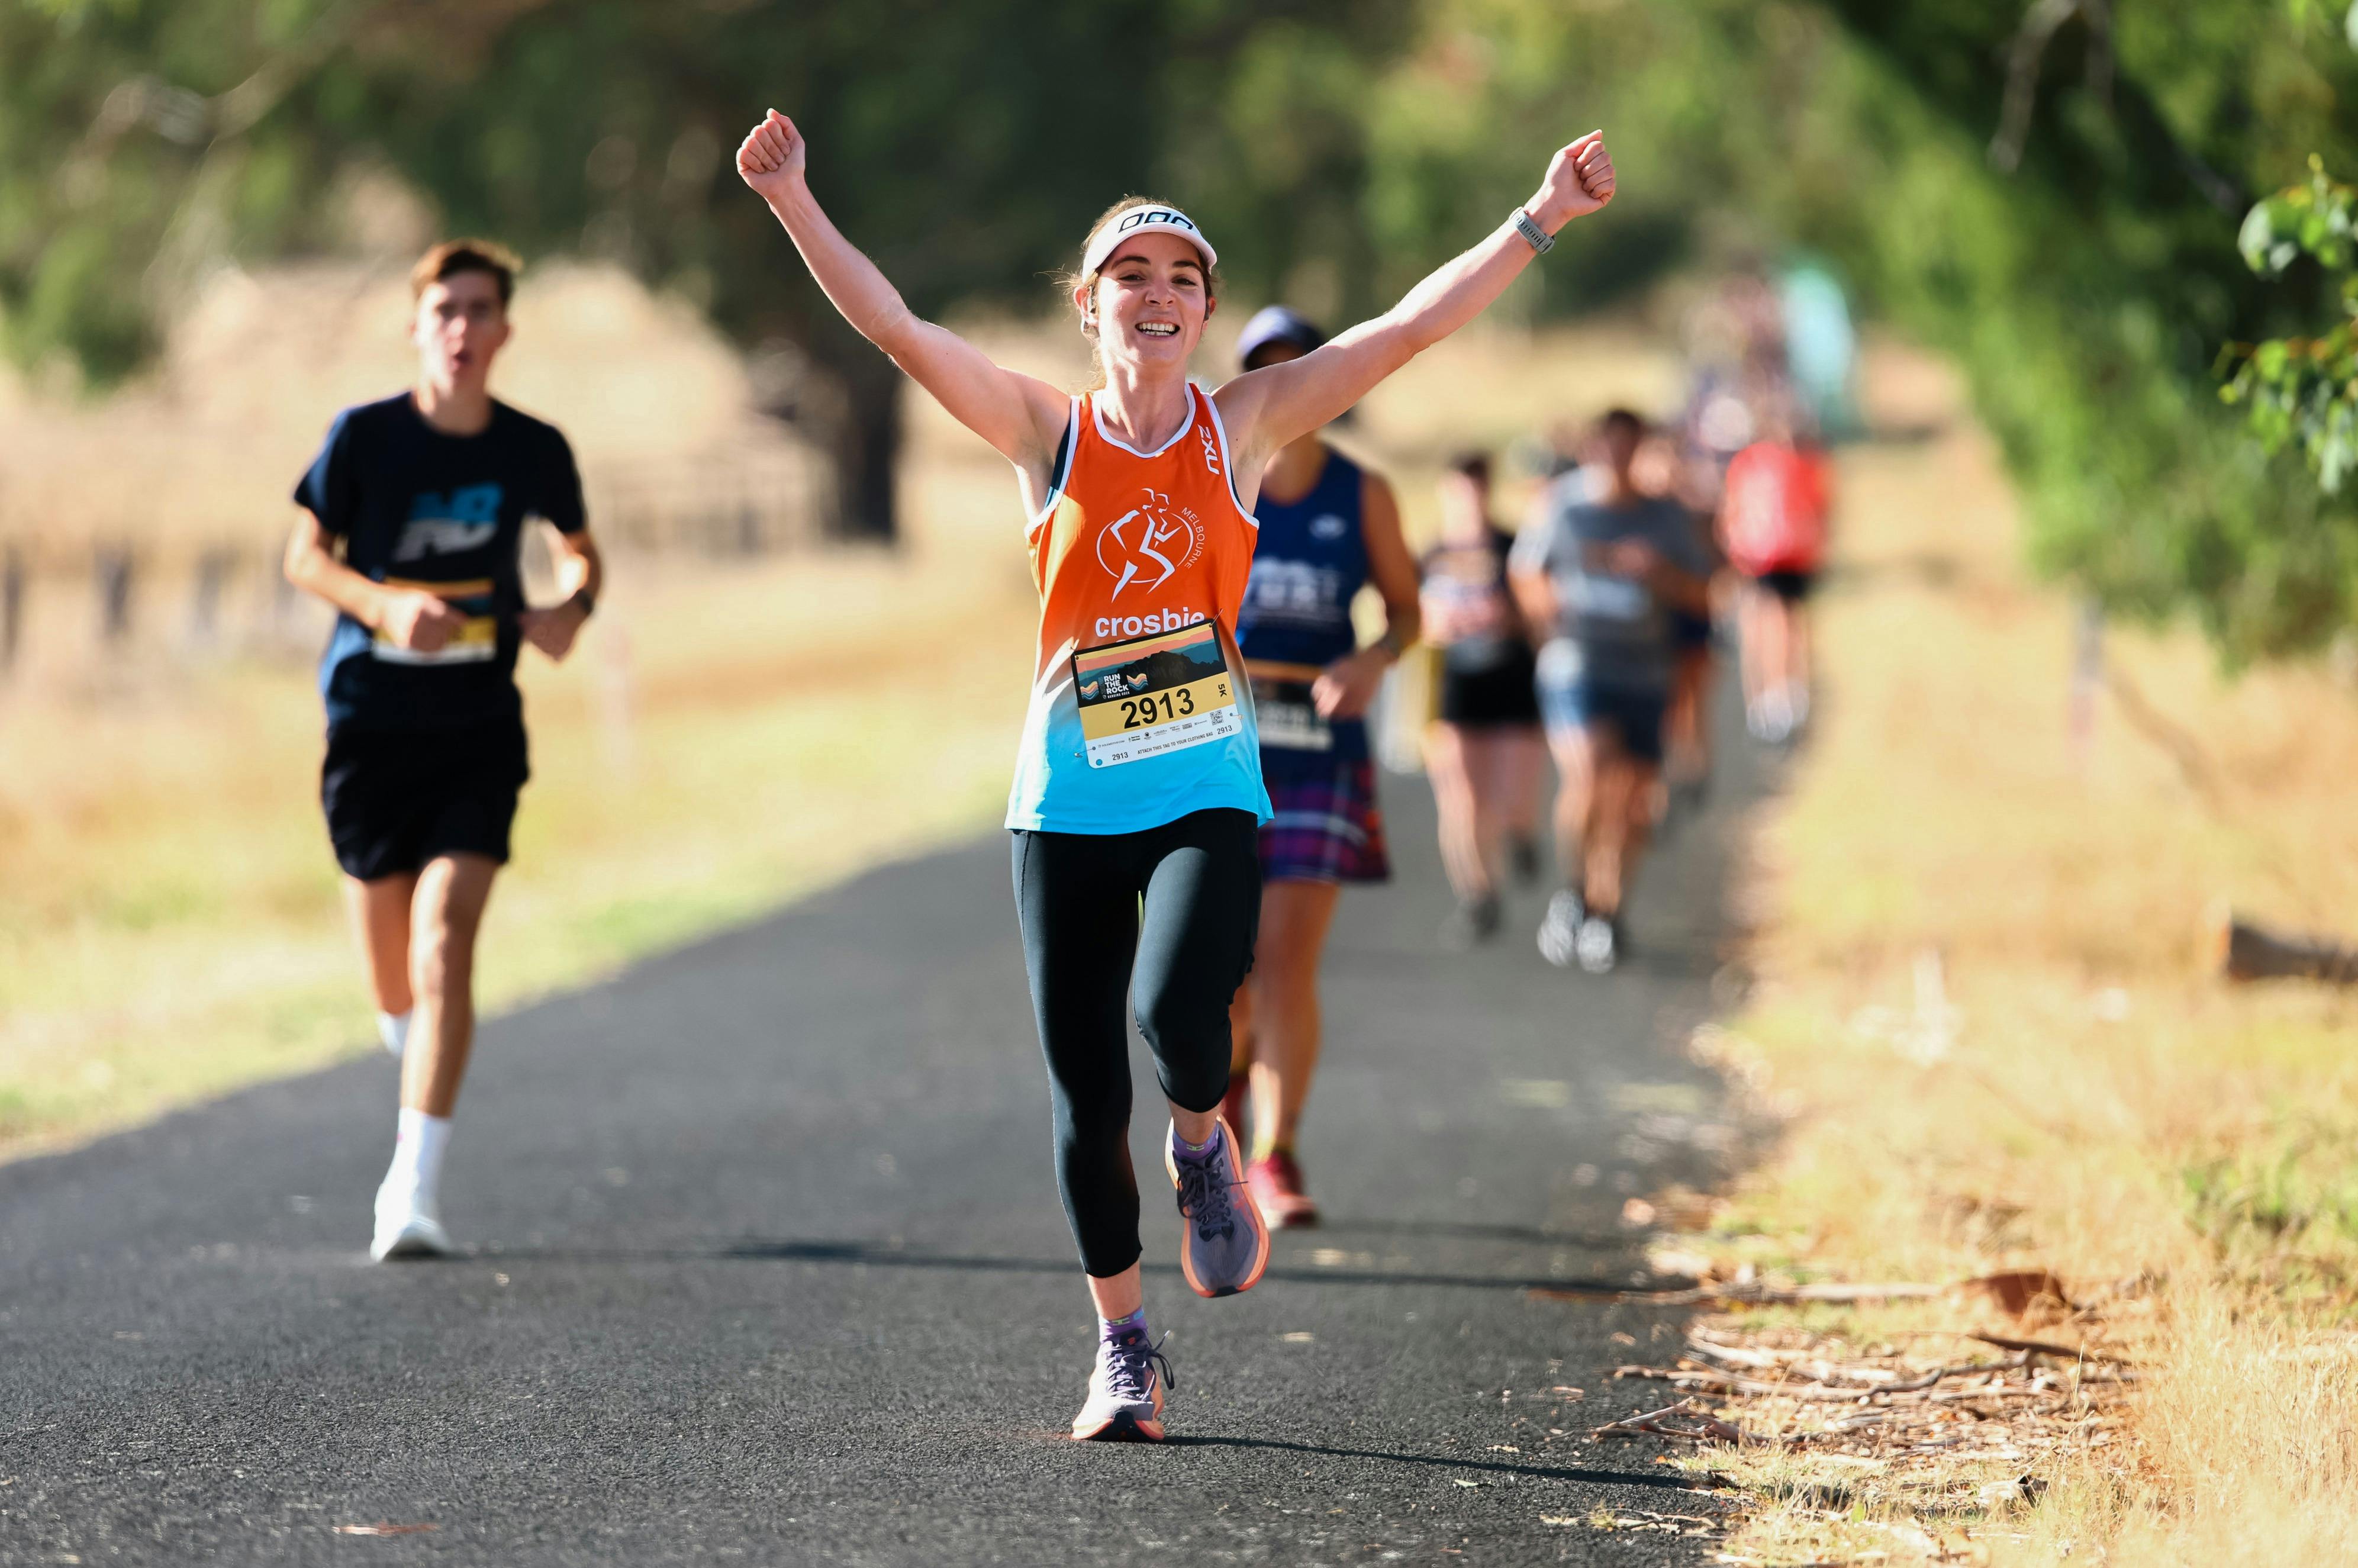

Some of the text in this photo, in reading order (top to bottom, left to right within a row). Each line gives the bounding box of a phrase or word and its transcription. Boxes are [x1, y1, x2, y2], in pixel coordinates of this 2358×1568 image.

[1181, 507, 1205, 569] MELBOURNE
[1104, 674, 1120, 682] RUN
[1106, 684, 1129, 694] ROCK
[1218, 683, 1227, 697] 5K
[1120, 688, 1194, 729] 2913
[1217, 725, 1232, 735] 2913
[1138, 746, 1152, 755] ATTACH
[1187, 733, 1205, 742] CLOTHING
[1112, 751, 1129, 761] 2913
